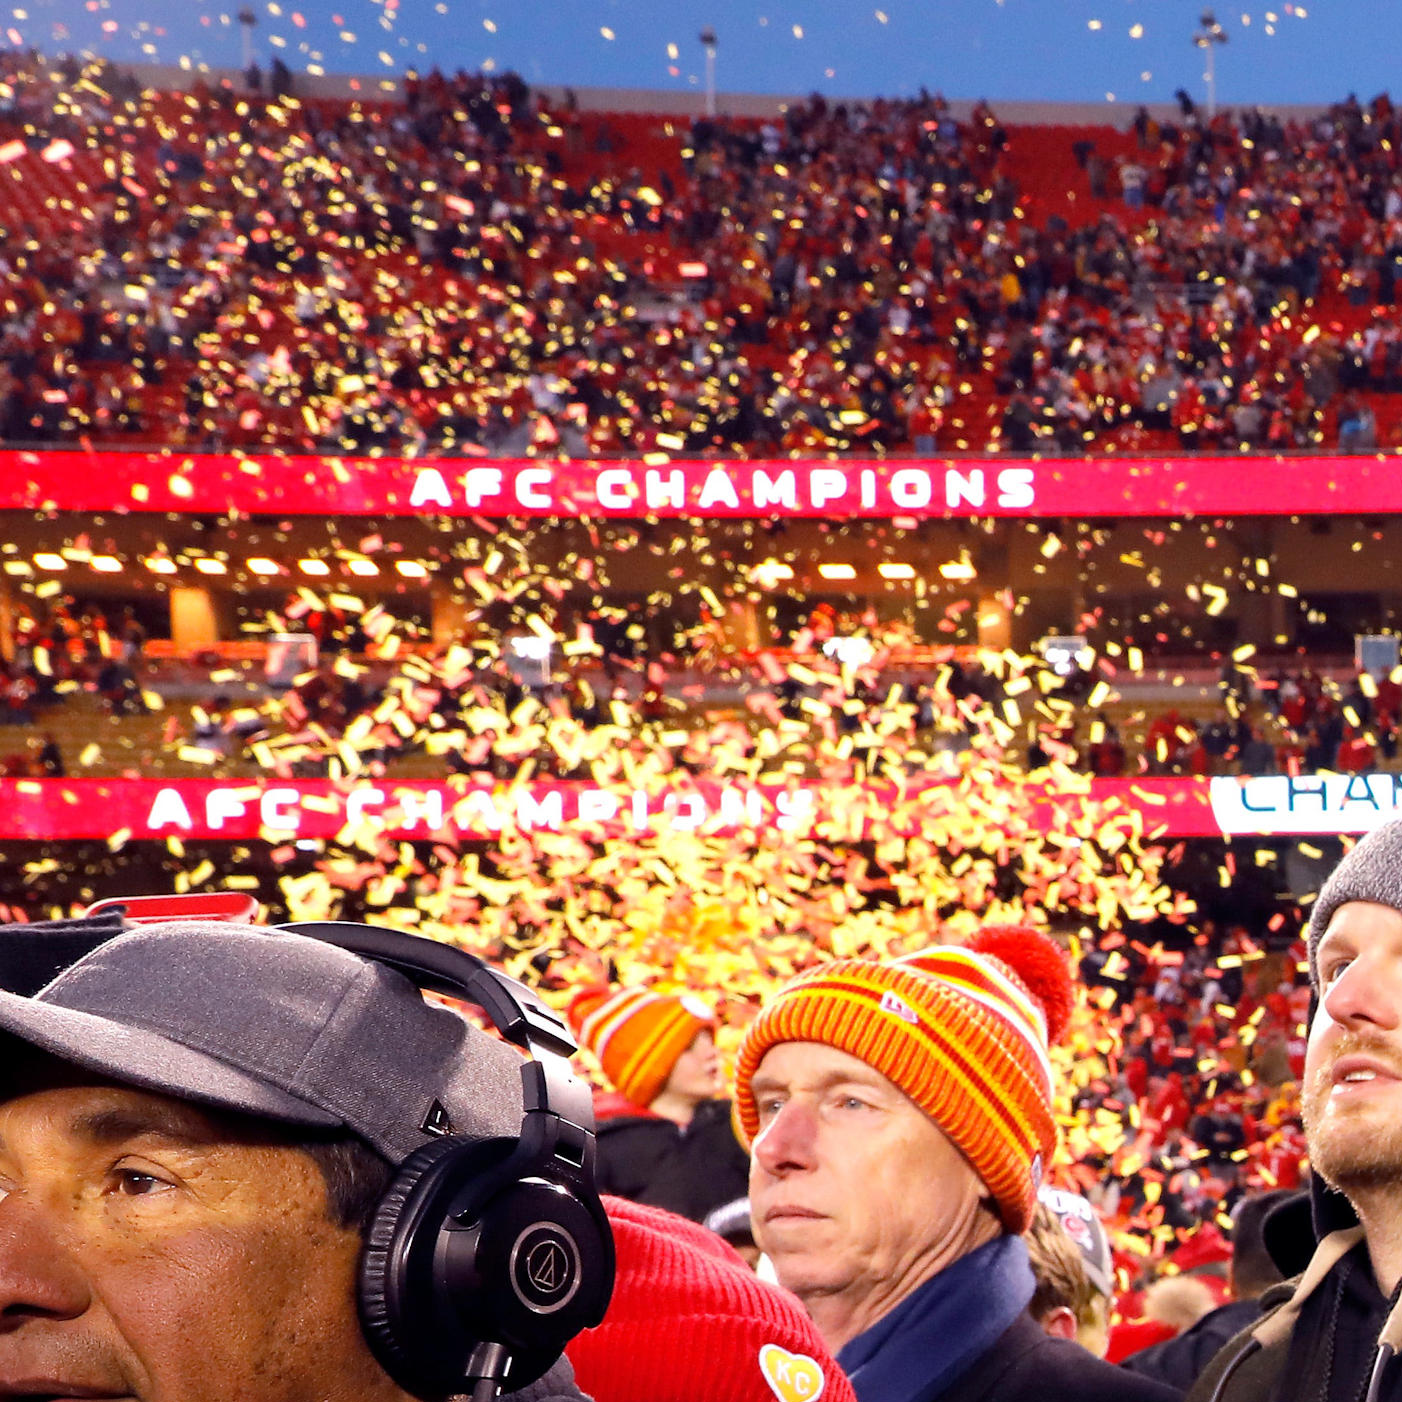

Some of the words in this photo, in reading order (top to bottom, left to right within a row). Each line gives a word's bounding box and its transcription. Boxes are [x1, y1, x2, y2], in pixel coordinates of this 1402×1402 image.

[409, 468, 552, 509] AFC
[596, 468, 1036, 510] CHAMPIONS
[146, 788, 300, 830] AFC
[775, 1360, 812, 1395] KC
